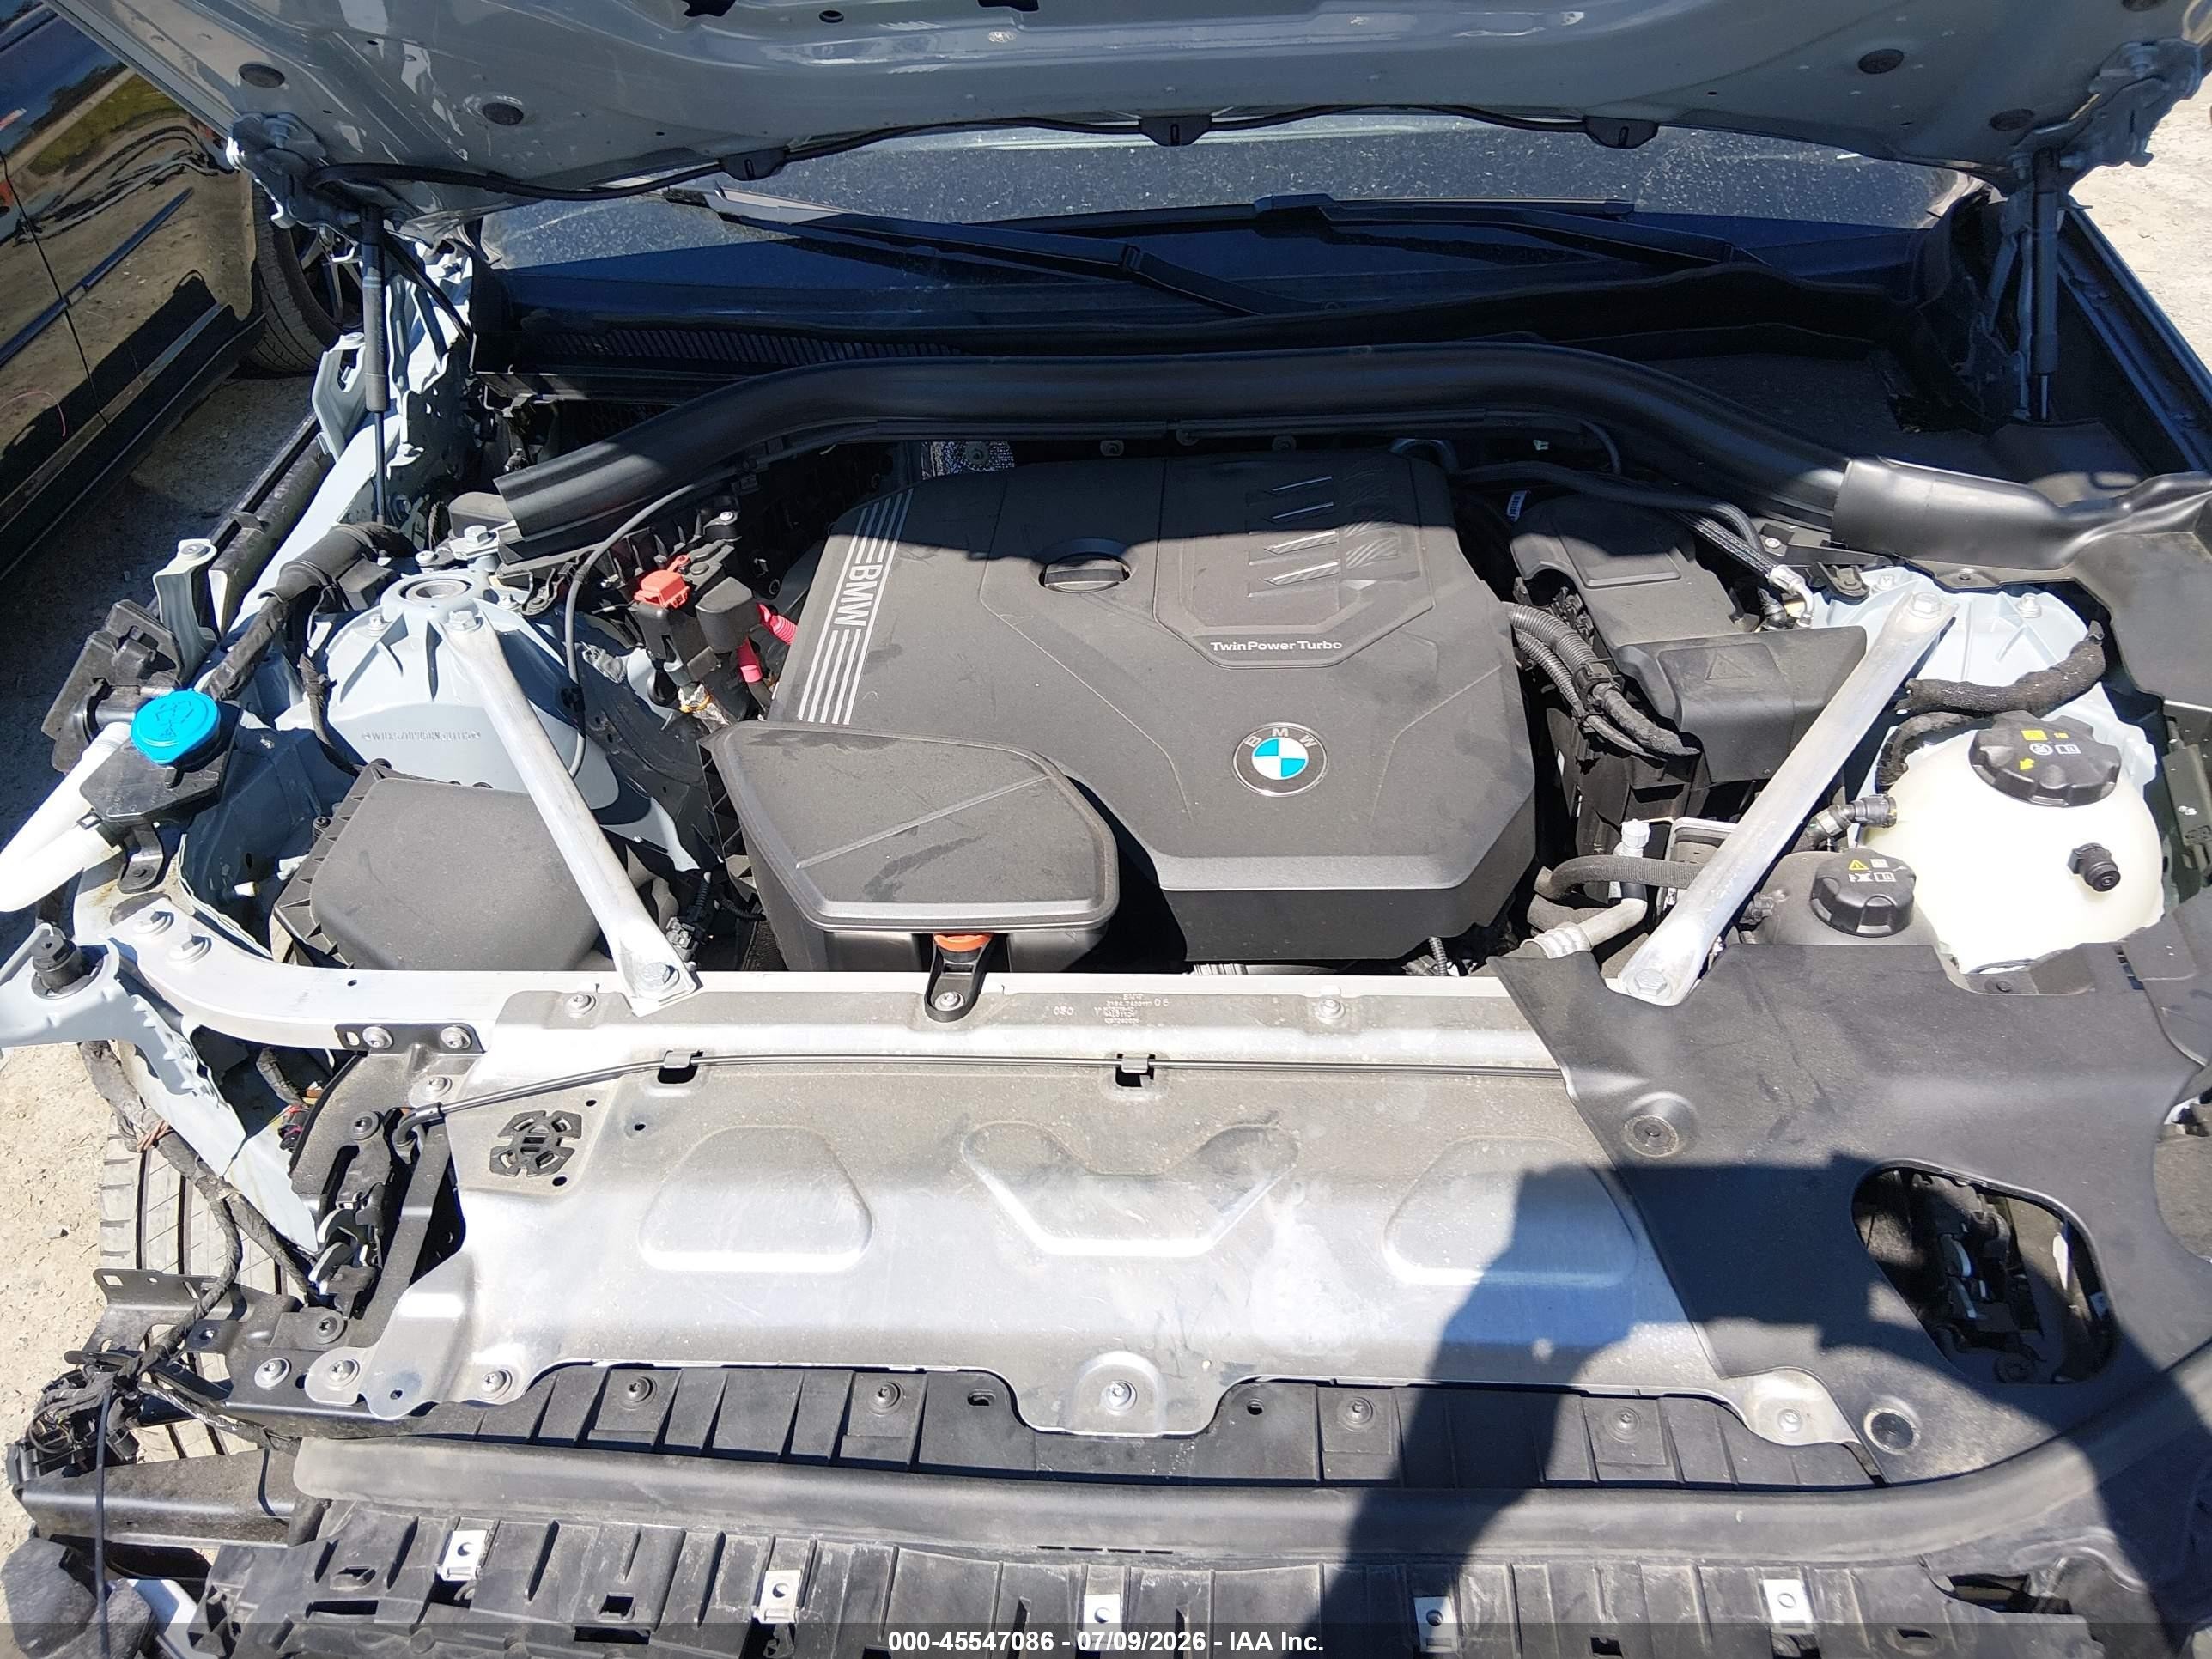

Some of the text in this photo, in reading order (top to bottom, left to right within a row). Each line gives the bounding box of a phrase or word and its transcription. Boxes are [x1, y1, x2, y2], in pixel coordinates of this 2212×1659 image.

[834, 564, 883, 626] BMW
[1297, 640, 1343, 650] Turbo
[1243, 727, 1317, 748] BMW
